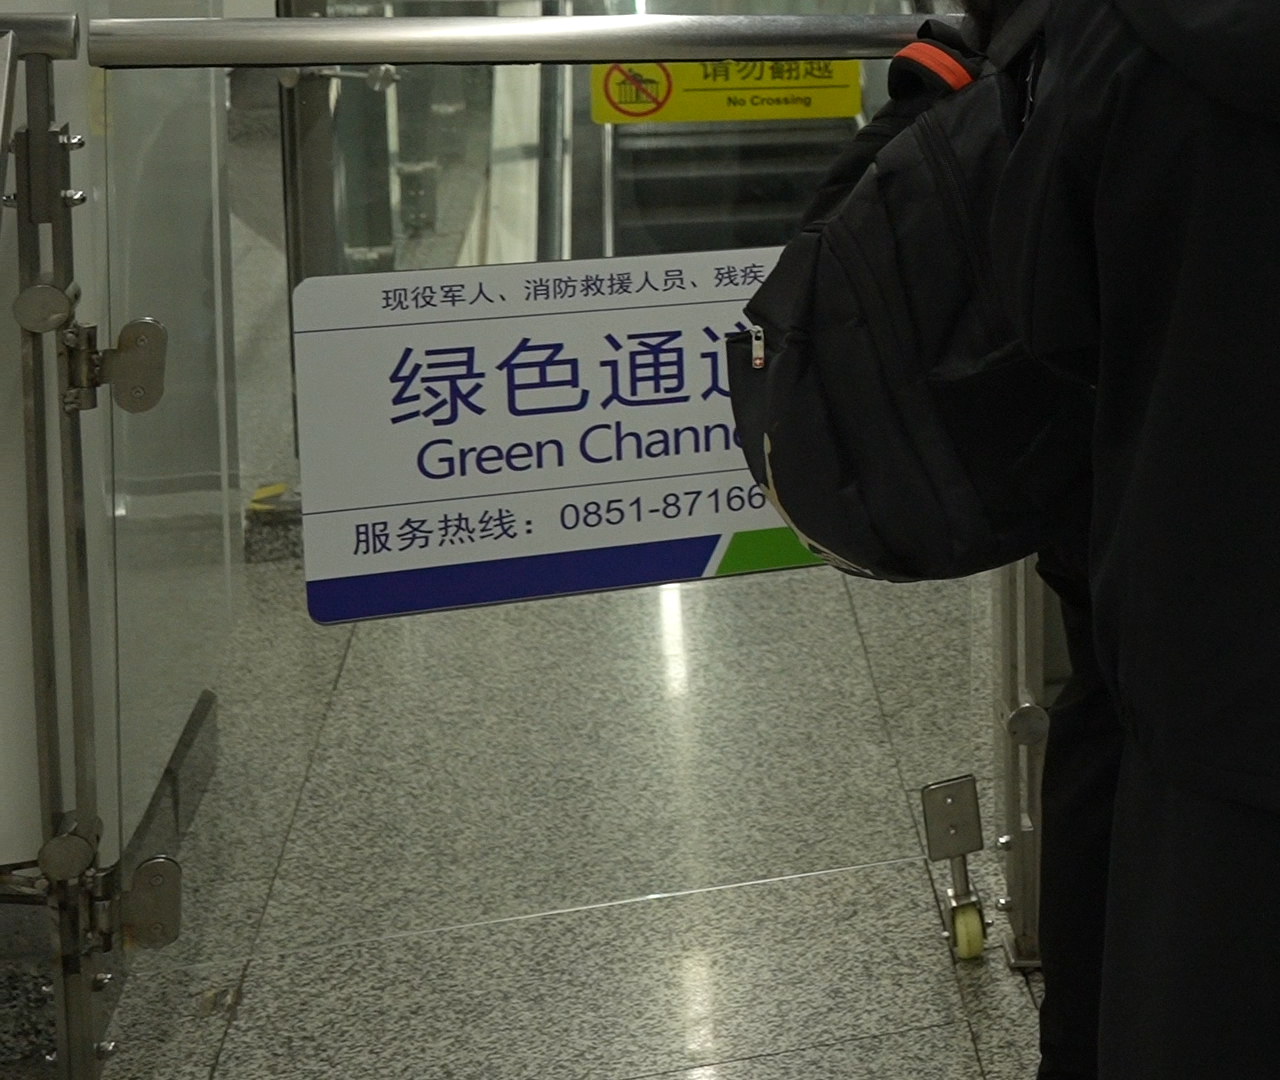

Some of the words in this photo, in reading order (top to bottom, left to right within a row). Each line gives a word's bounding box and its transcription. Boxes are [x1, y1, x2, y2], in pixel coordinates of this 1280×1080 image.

[700, 60, 834, 82] 请勿翻越
[726, 95, 747, 107] No
[750, 94, 812, 108] Crossing
[381, 263, 767, 312] 现役军人、消防救援人员、残疾
[416, 435, 565, 480] Green
[559, 483, 767, 532] 0851-87166
